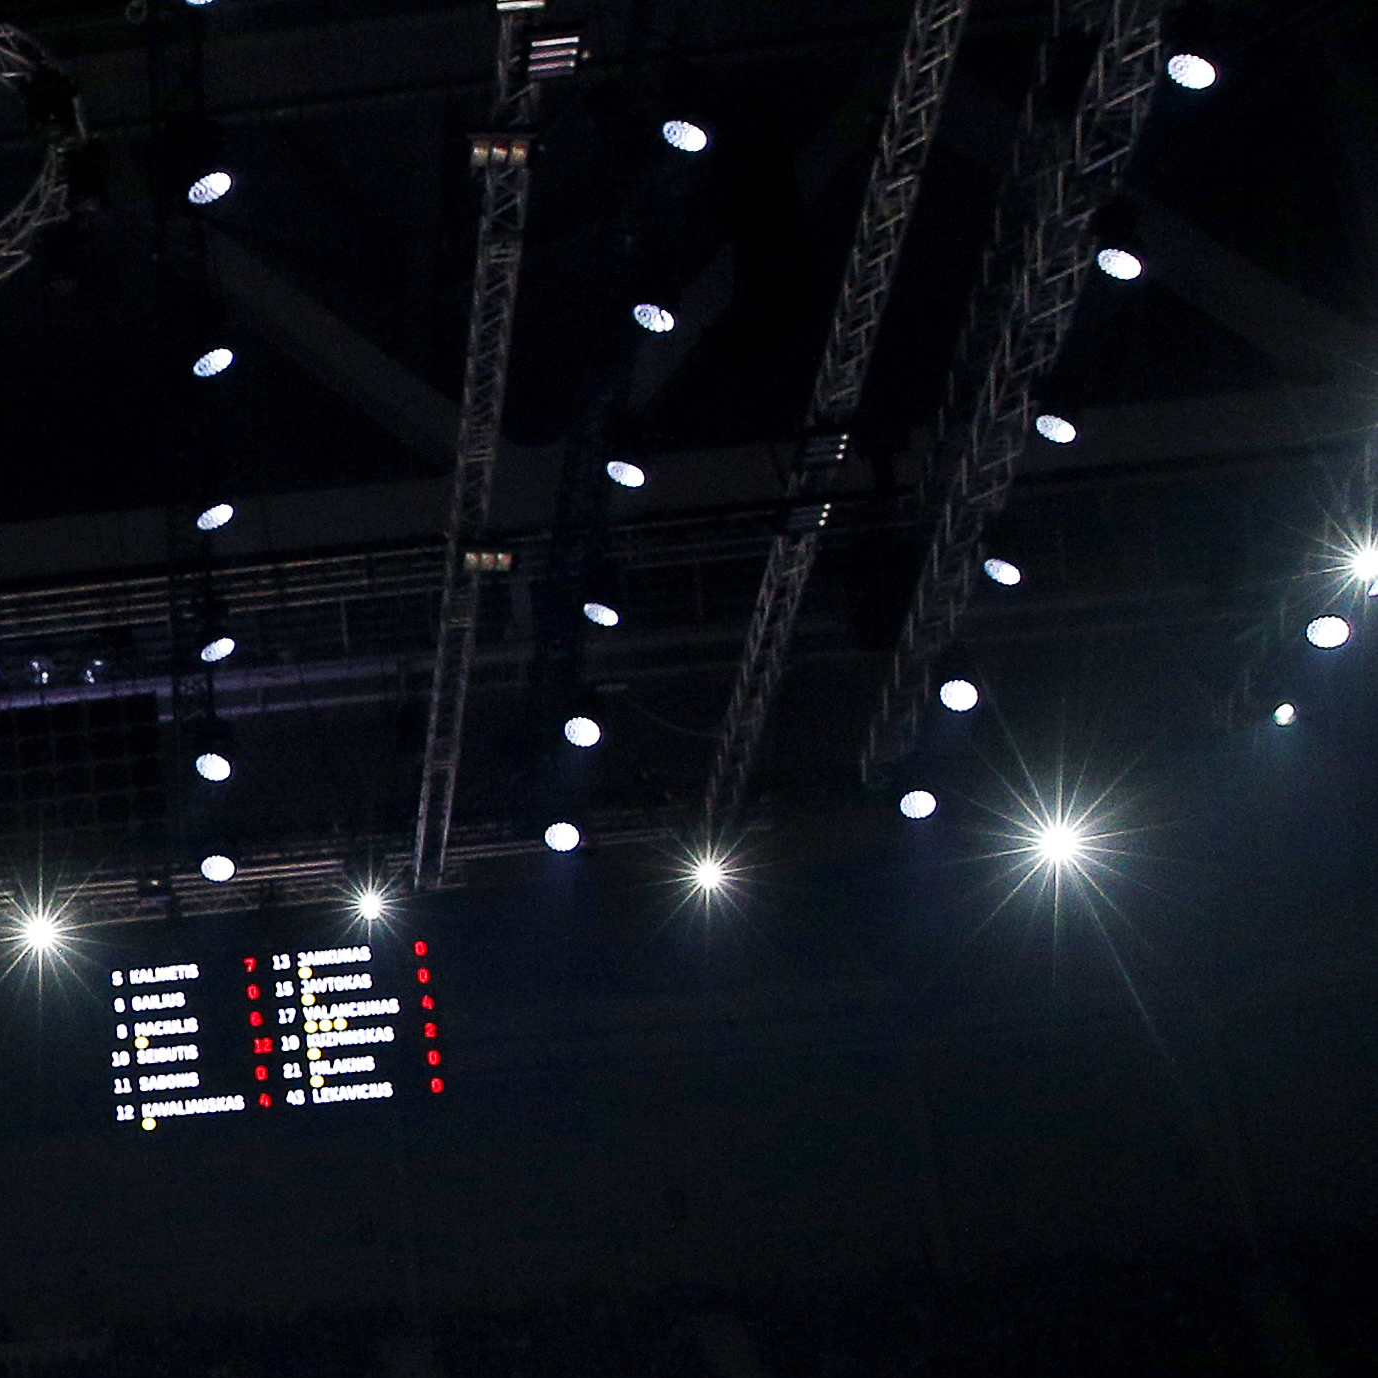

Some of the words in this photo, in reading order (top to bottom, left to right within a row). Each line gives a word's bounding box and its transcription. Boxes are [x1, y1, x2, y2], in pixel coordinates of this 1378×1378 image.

[273, 954, 290, 970] 13
[414, 941, 427, 955] 0
[276, 981, 293, 997] 15
[417, 968, 430, 983] 0
[278, 1008, 296, 1024] 17
[421, 996, 434, 1009] 4
[424, 1023, 437, 1037] 2
[112, 1051, 130, 1067] 10
[254, 1038, 273, 1053] 12
[283, 1063, 302, 1078] 21
[427, 1050, 440, 1065] 0
[114, 1078, 132, 1094] 11
[255, 1066, 268, 1081] 0
[431, 1078, 444, 1093] 0
[117, 1105, 134, 1120] 12
